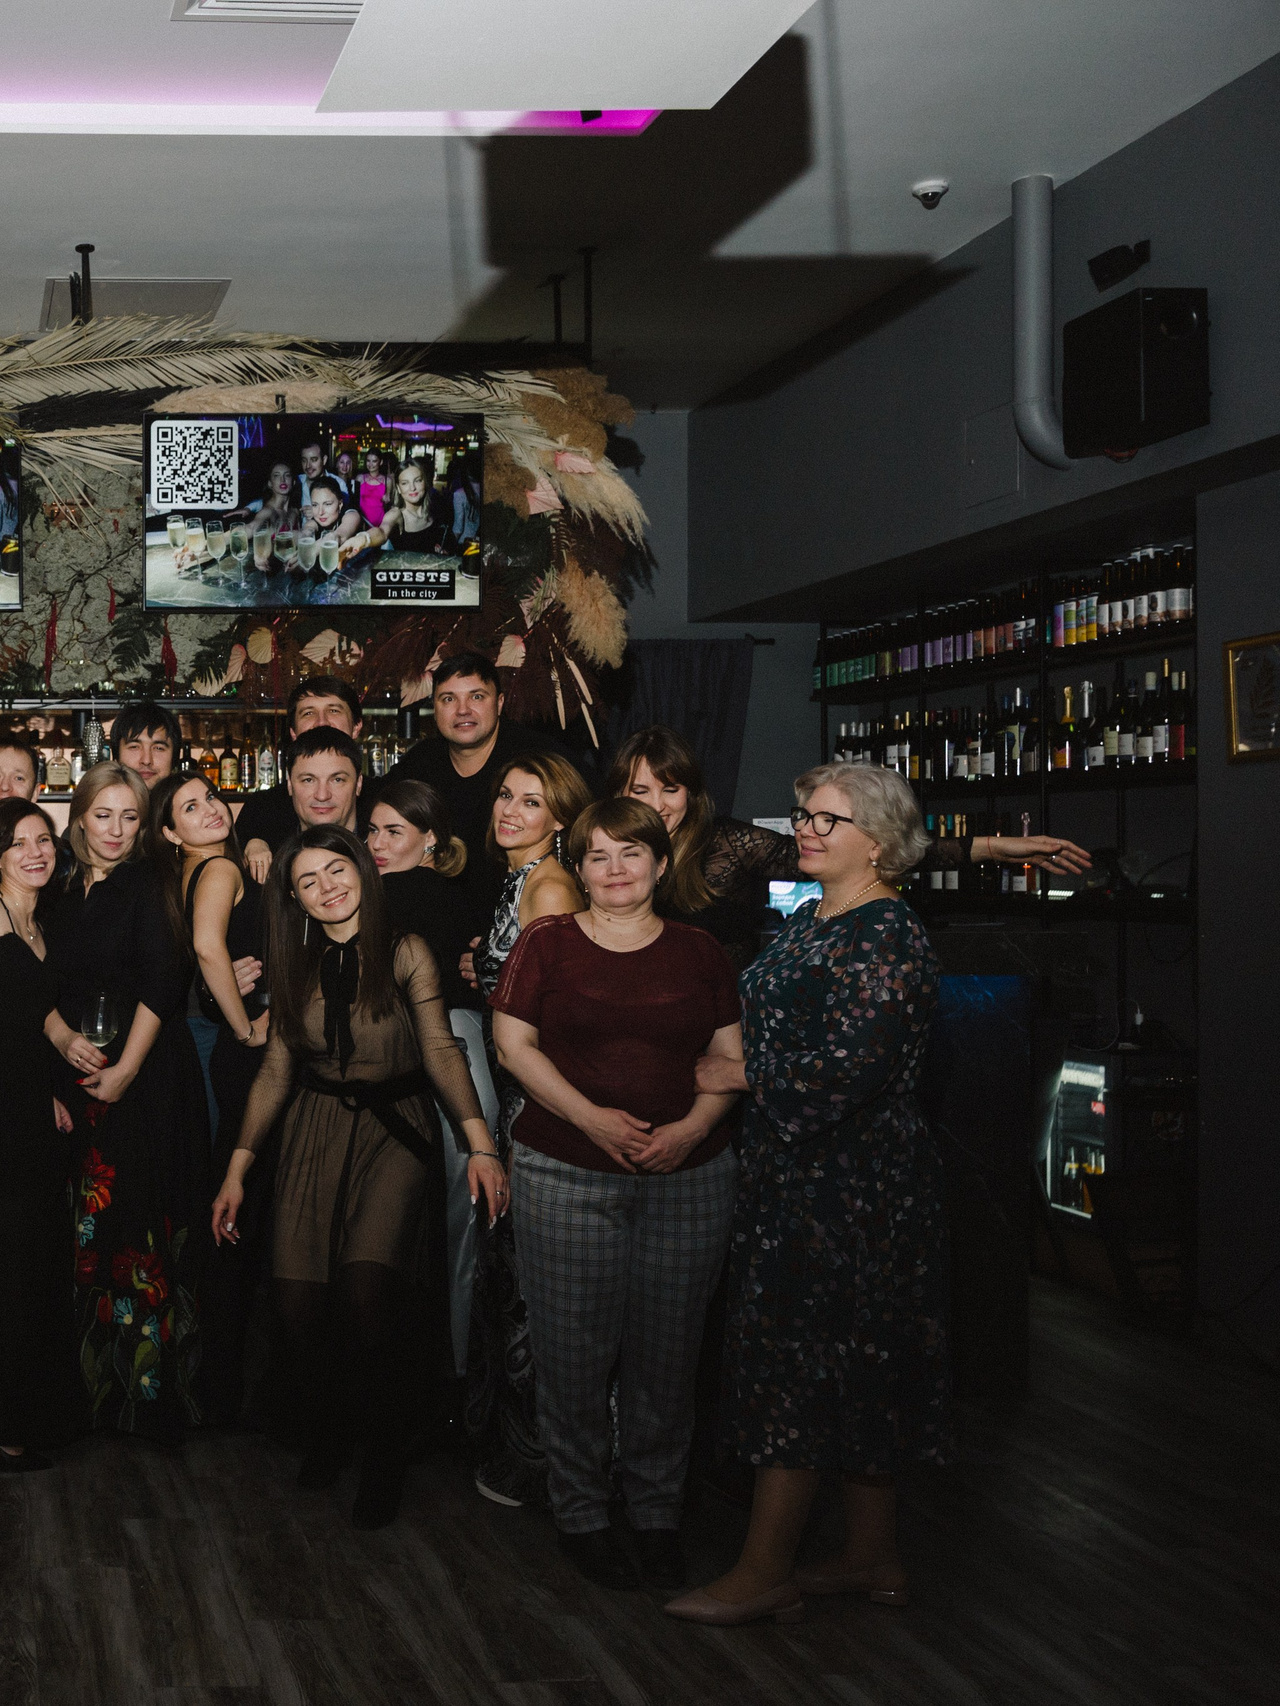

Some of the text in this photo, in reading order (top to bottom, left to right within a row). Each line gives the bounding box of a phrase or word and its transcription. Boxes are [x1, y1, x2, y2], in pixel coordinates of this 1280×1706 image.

[375, 571, 450, 582] GUESTS
[388, 589, 438, 599] In the city
